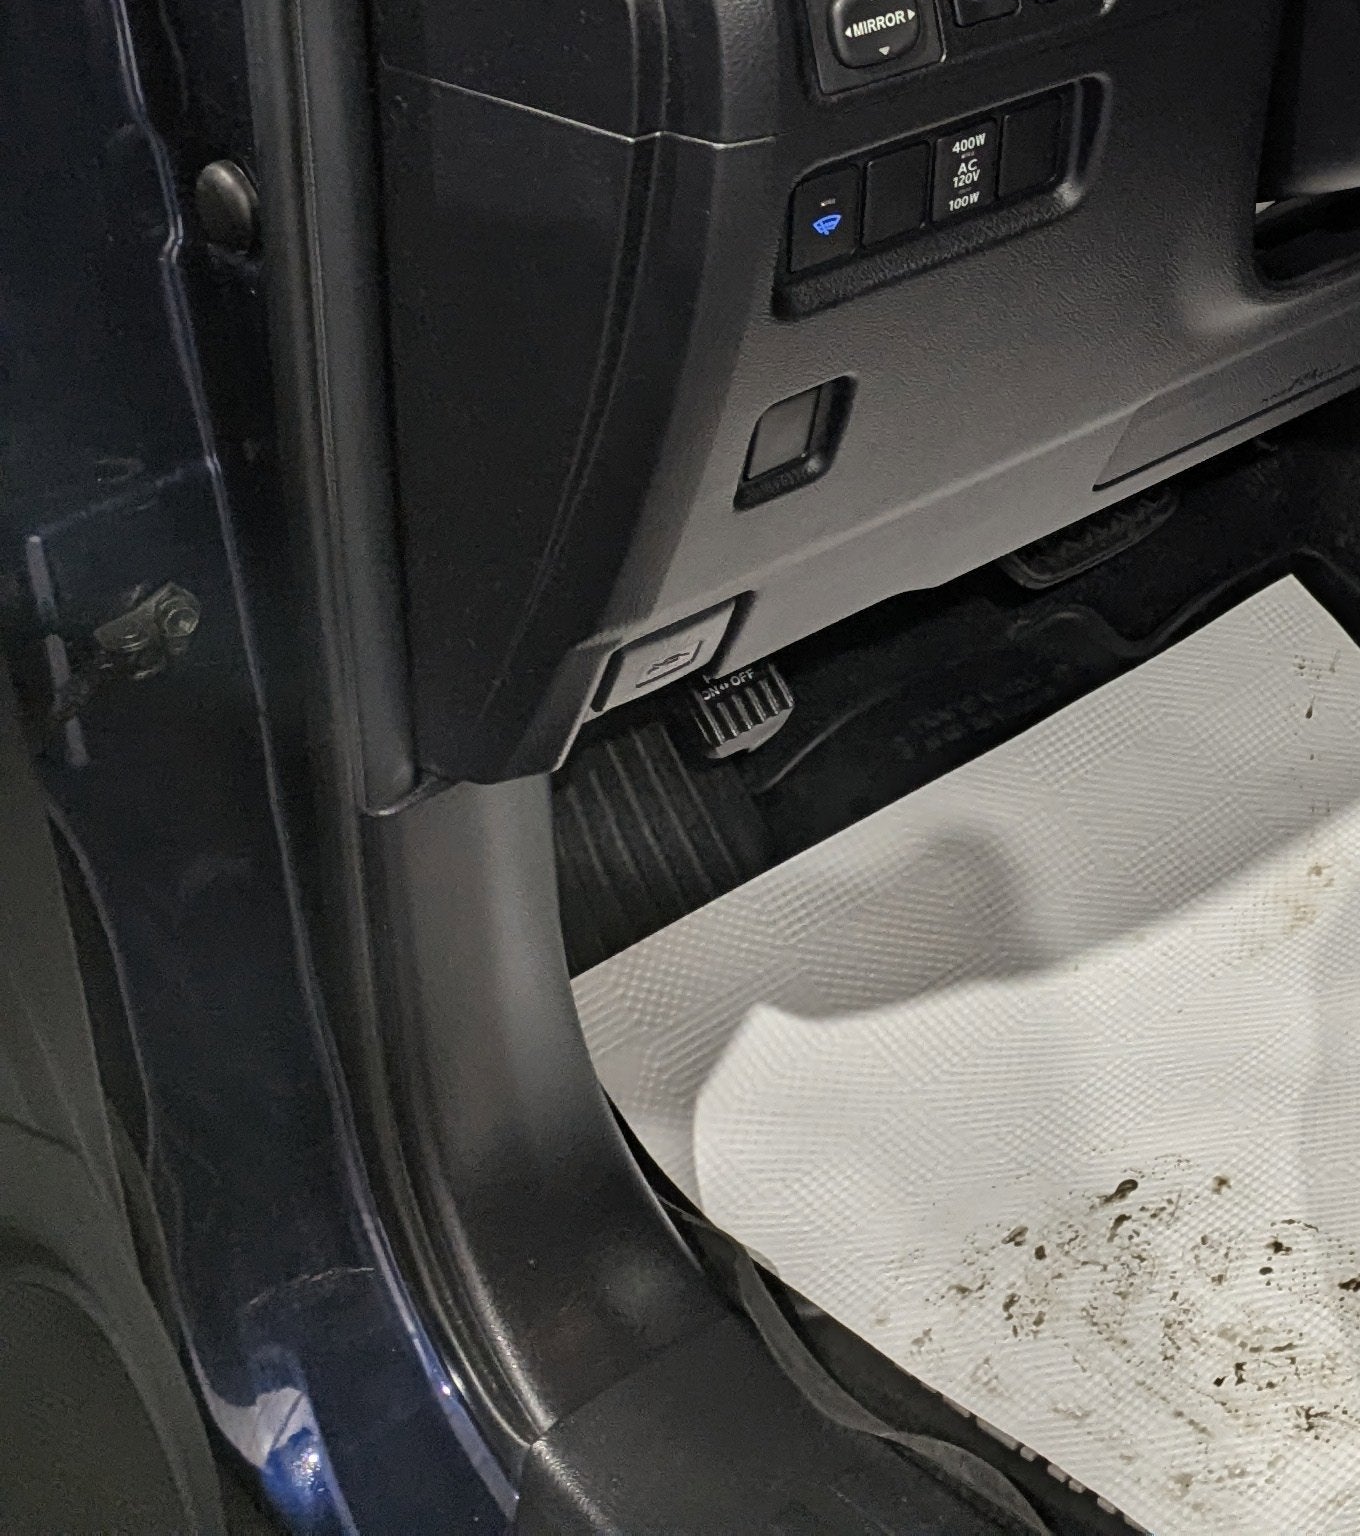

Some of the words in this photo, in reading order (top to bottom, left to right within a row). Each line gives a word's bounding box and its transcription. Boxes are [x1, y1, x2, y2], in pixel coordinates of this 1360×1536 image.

[852, 10, 906, 38] MIRROR
[952, 133, 987, 154] 400W
[958, 159, 978, 175] AC
[952, 170, 981, 188] 120V
[948, 191, 980, 212] 100W
[701, 685, 720, 701] ON
[730, 668, 755, 686] OFF
